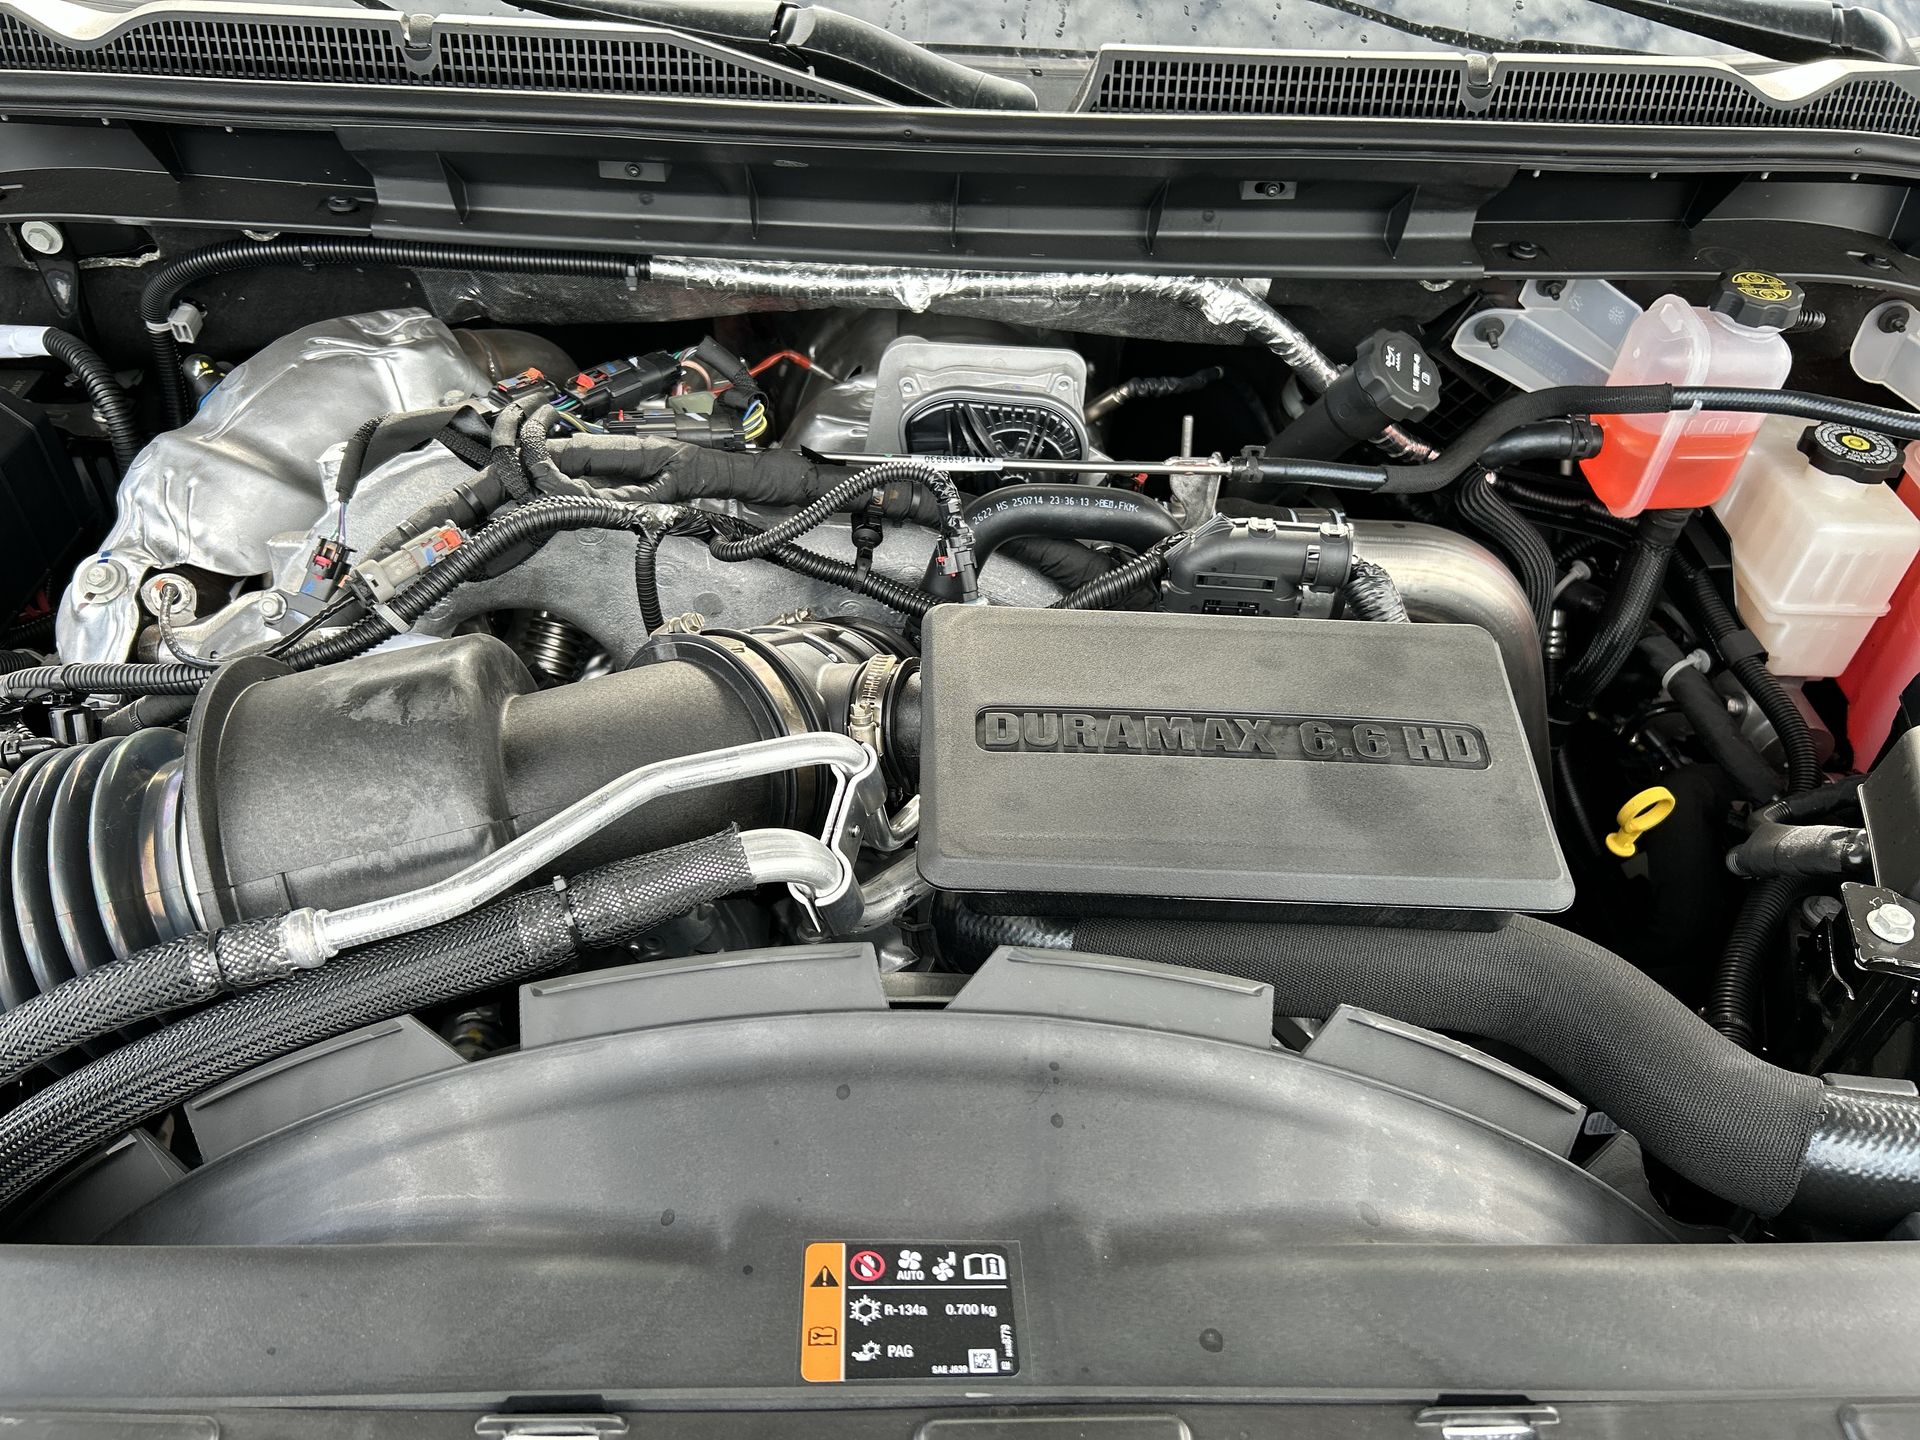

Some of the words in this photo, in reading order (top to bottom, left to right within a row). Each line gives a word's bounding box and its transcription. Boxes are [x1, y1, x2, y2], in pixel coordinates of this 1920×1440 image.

[972, 507, 993, 525] 2622
[996, 501, 1009, 512] HS
[1012, 496, 1043, 507] 250714
[1050, 496, 1090, 507] 23:36:13
[984, 712, 1278, 754] DURAMAX
[1300, 721, 1390, 759] 6.6
[1405, 726, 1482, 763] HD
[897, 1270, 925, 1281] AUTO
[884, 1304, 928, 1316] R-134a
[945, 1304, 979, 1316] 0.700
[981, 1303, 998, 1317] kg
[887, 1345, 914, 1358] PAG
[931, 1365, 948, 1374] SAE
